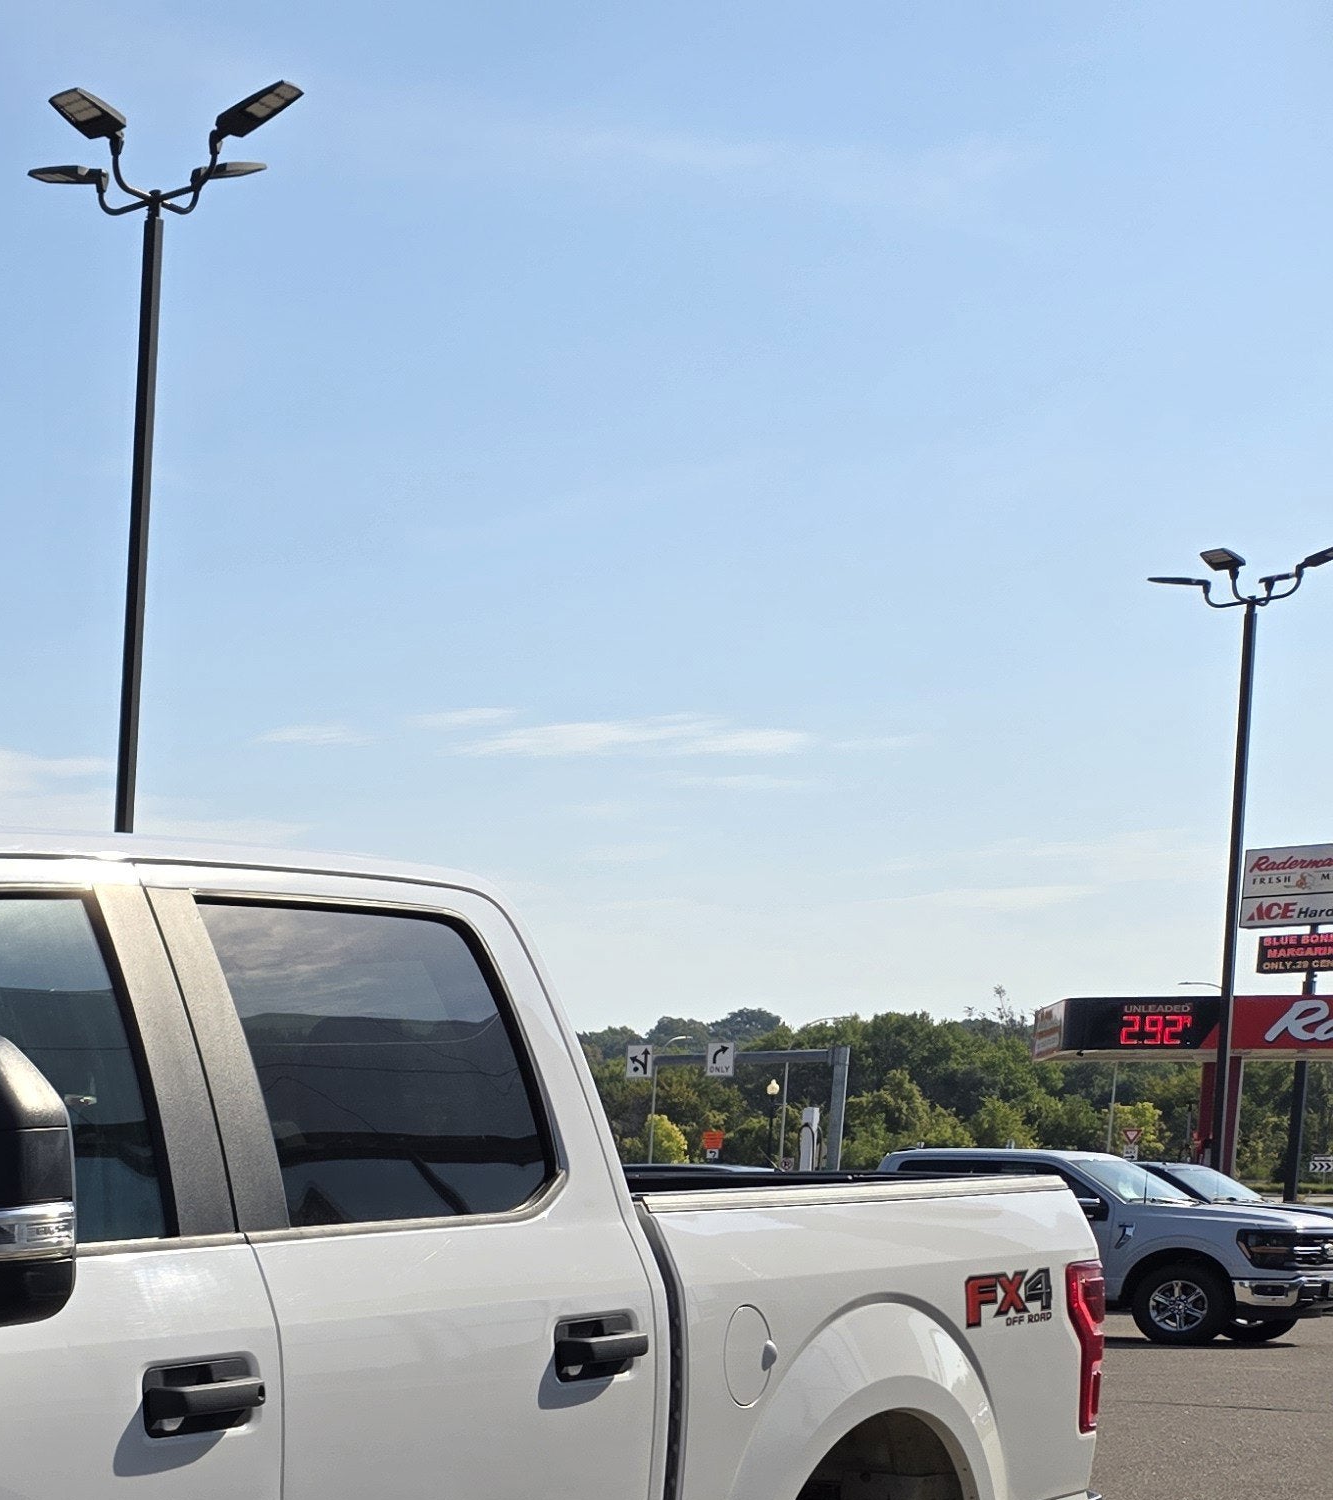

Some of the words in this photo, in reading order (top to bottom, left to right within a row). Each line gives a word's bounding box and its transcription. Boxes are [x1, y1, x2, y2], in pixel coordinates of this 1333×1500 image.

[1252, 876, 1291, 885] FRESH
[1247, 902, 1298, 921] ACE
[1263, 935, 1297, 946] BLUE
[1124, 1004, 1190, 1013] UNLEADED
[709, 1065, 730, 1073] ONLY
[965, 1267, 1053, 1329] FX4
[1006, 1316, 1025, 1326] OFF
[1027, 1311, 1052, 1324] ROAD
